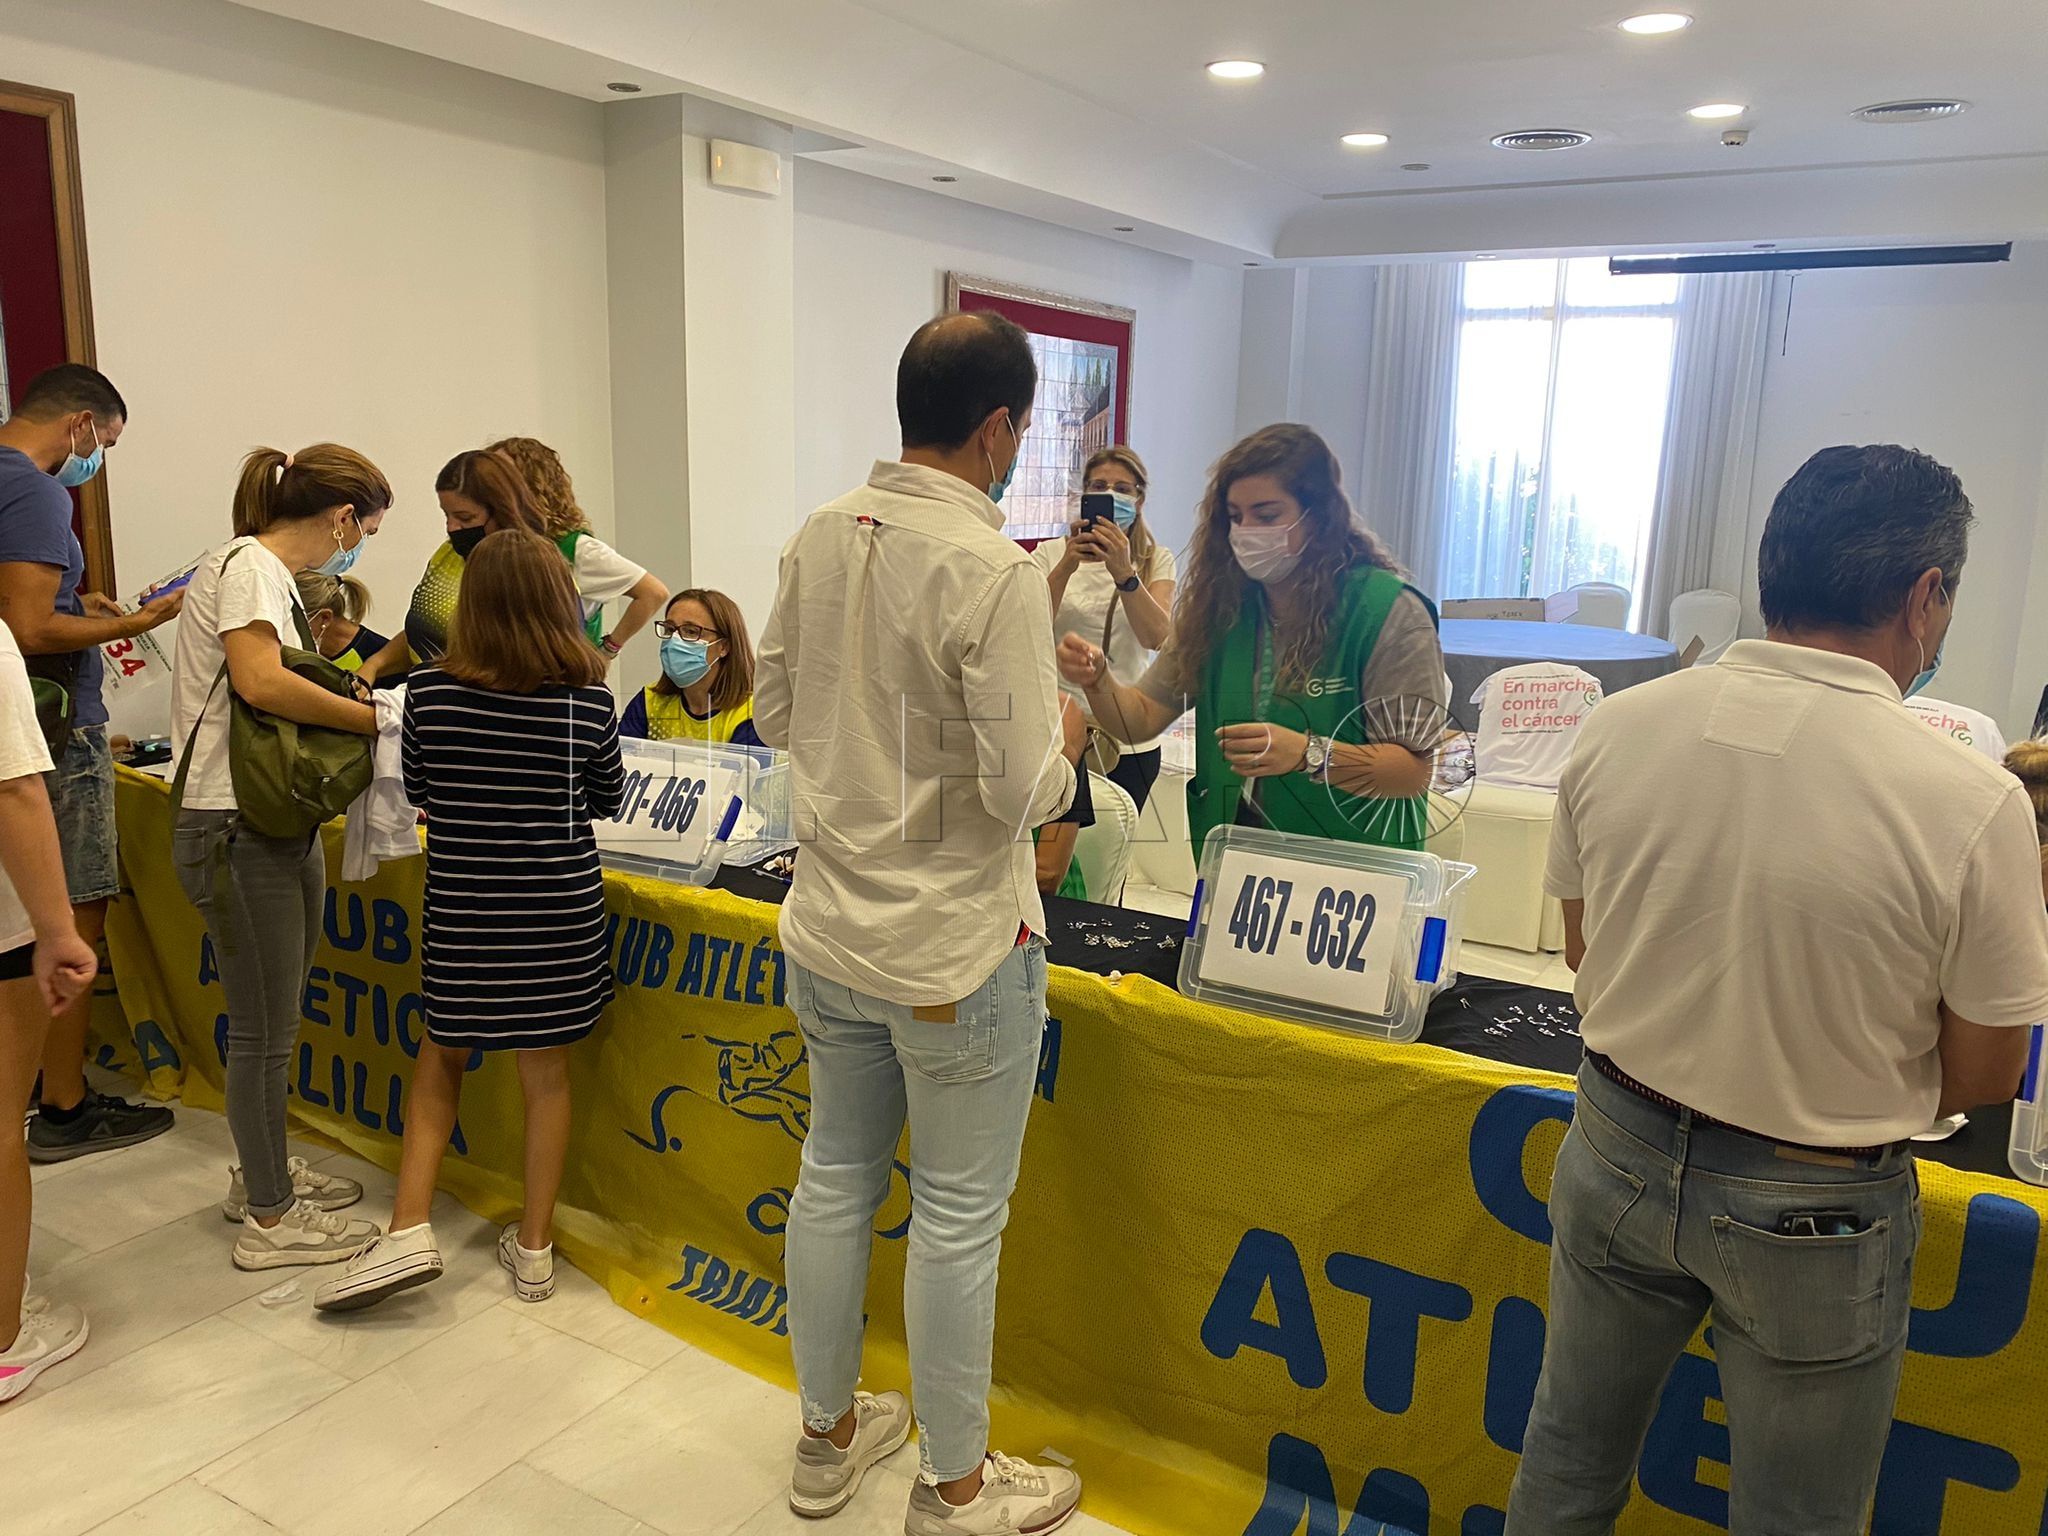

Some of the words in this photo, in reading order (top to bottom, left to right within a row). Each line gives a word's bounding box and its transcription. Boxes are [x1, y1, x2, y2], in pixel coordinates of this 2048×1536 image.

[1503, 681, 1524, 693] En
[1530, 678, 1597, 693] marcha
[1502, 696, 1558, 711] contra
[1501, 713, 1518, 728] el
[1522, 712, 1581, 727] cáncer
[612, 768, 706, 834] 01-466
